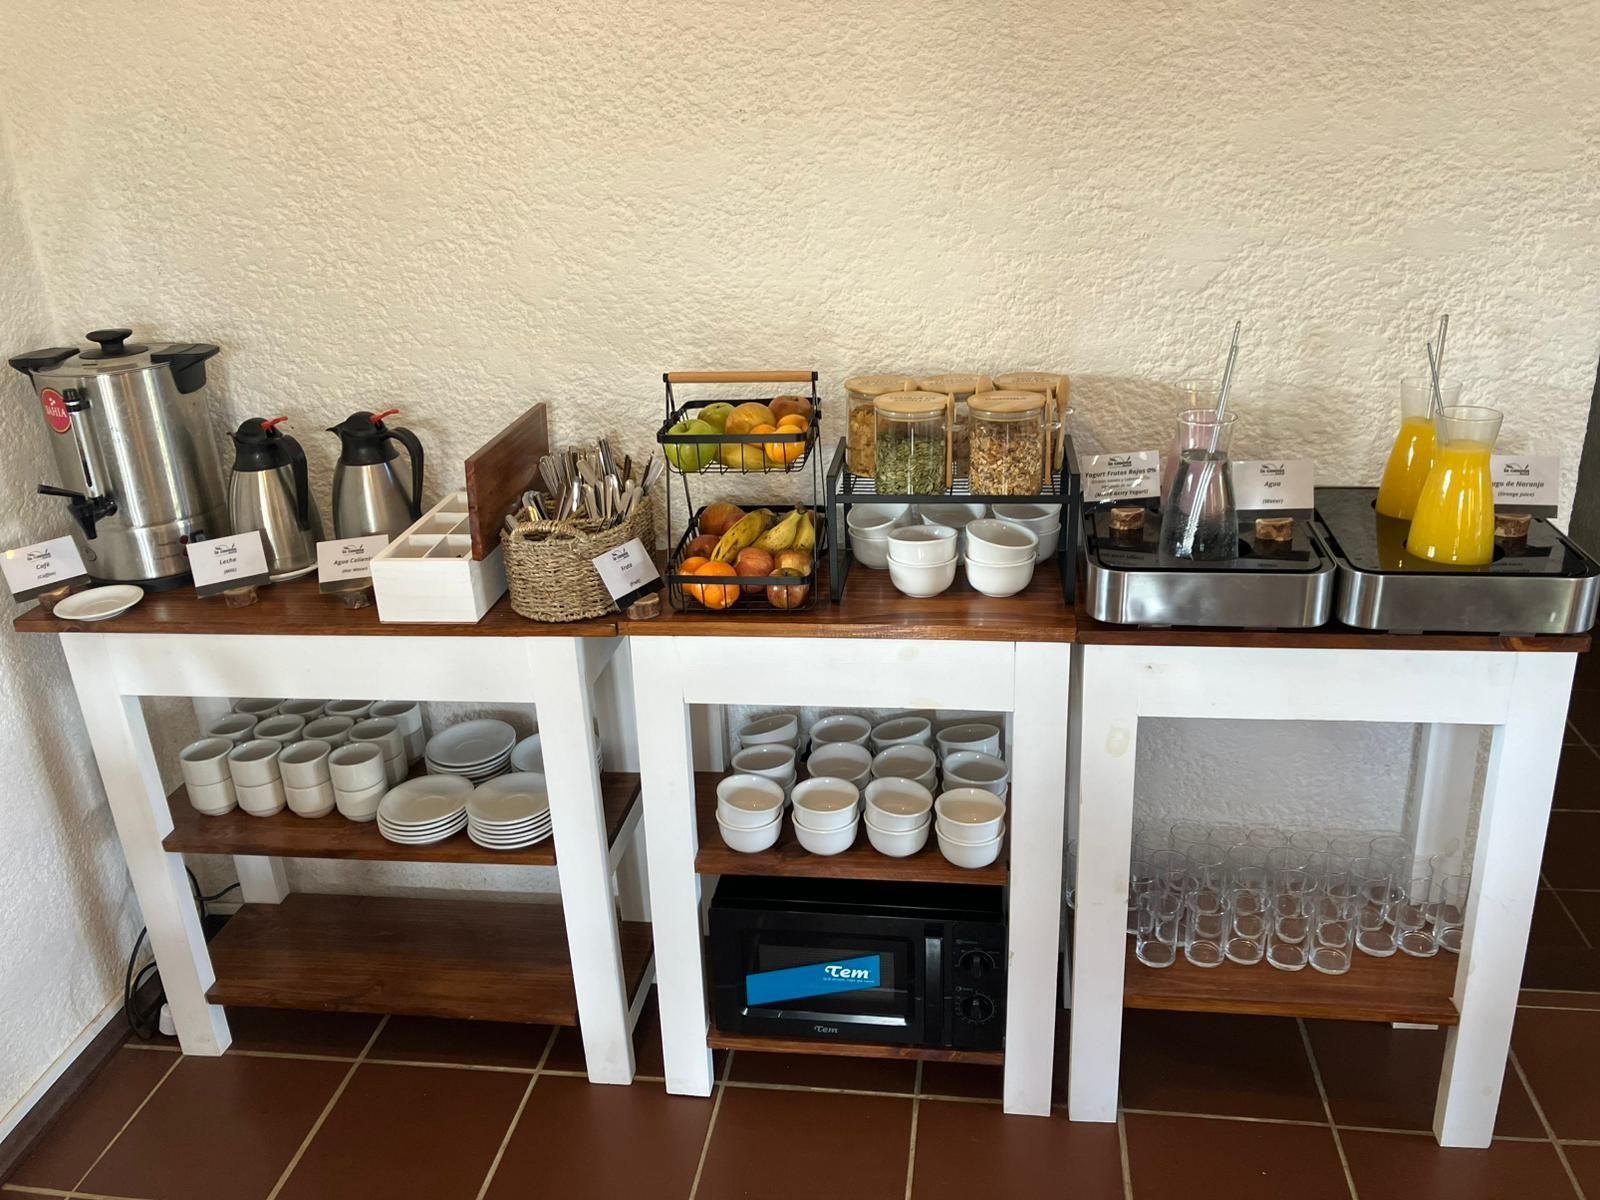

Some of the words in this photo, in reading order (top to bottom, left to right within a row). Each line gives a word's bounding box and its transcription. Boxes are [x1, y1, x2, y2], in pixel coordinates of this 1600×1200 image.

[1085, 471, 1106, 479] Yogurt
[1516, 480, 1545, 488] Naranja
[219, 557, 237, 565] Leche
[824, 965, 869, 979] Tem
[813, 1024, 838, 1034] Tem
